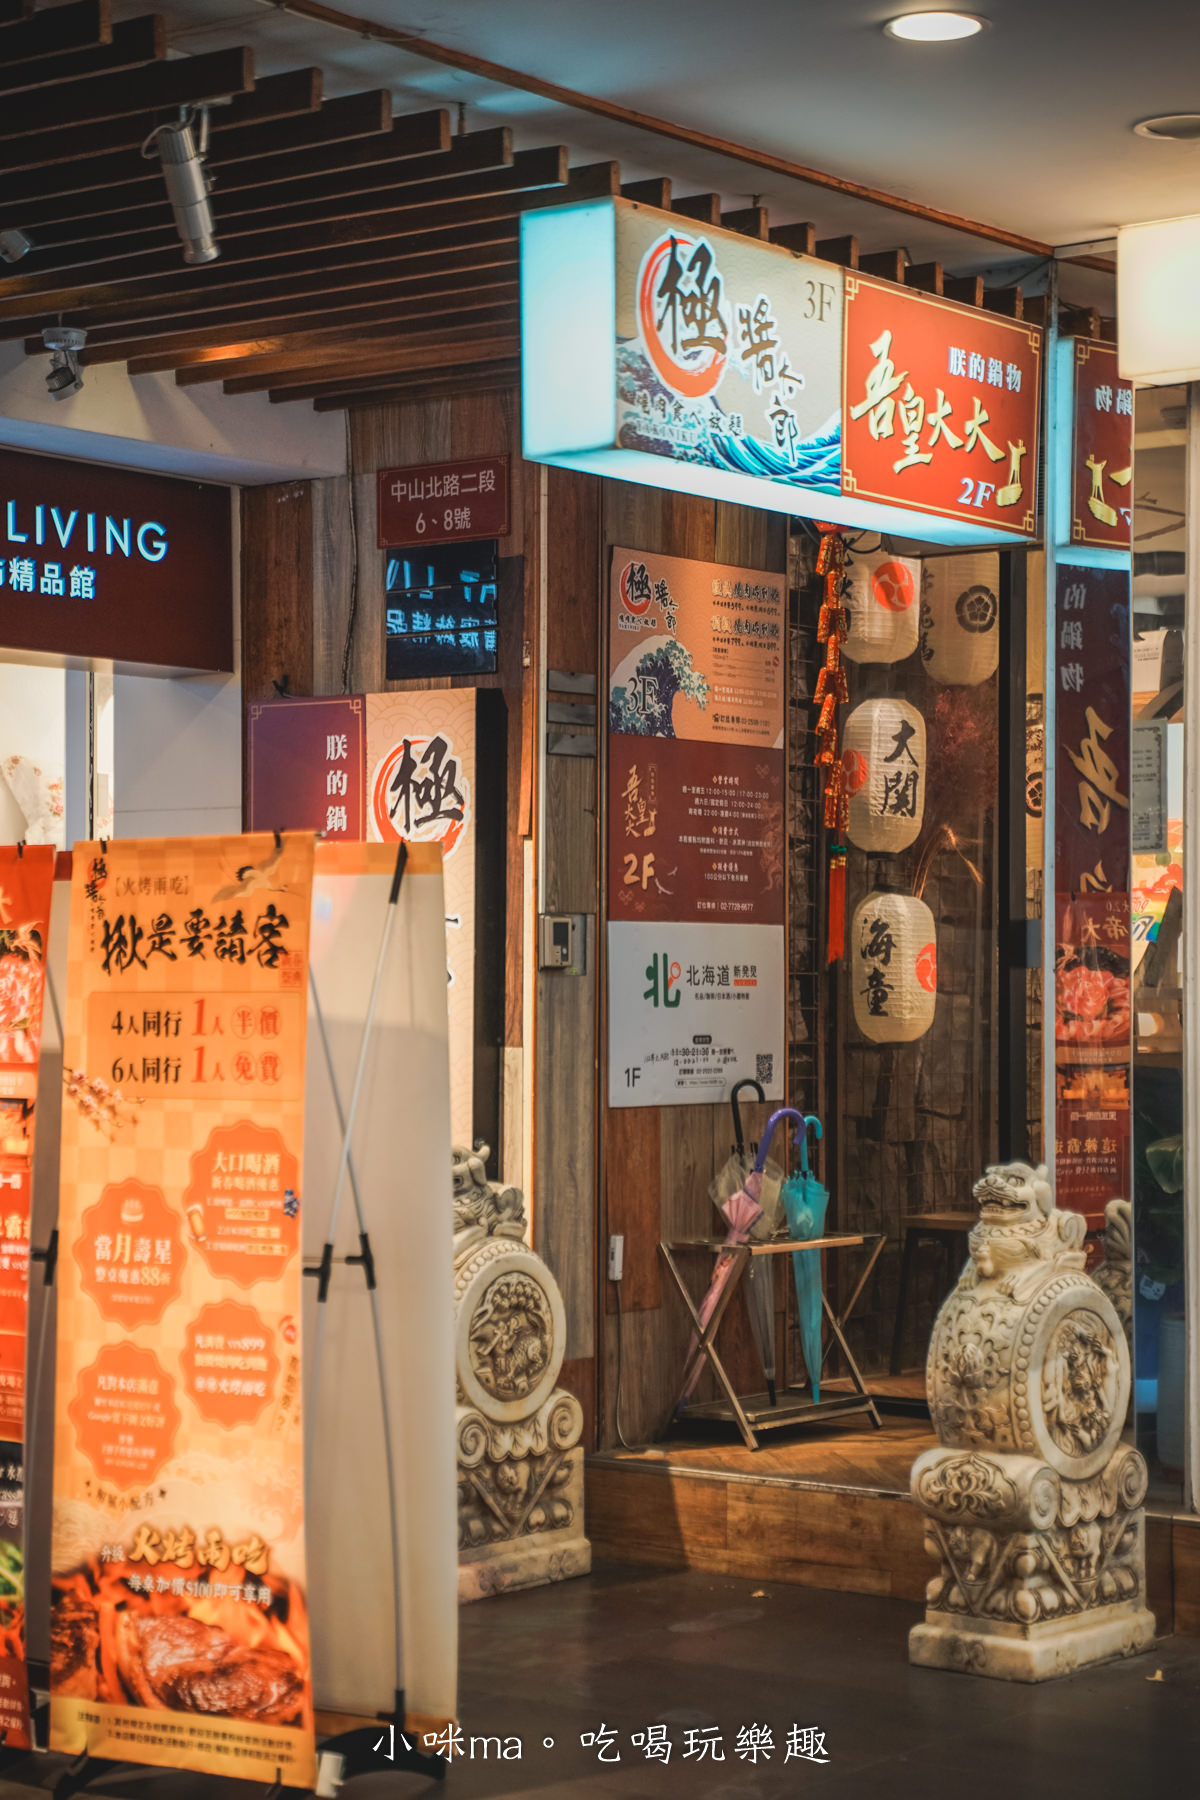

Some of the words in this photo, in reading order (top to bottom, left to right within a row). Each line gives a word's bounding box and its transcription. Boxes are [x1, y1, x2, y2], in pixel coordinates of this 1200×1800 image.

[804, 280, 836, 322] 3F
[949, 346, 1022, 393] 朕的鍋物
[851, 330, 1004, 474] 吾皇大大
[391, 469, 496, 503] 中山北路二段
[957, 477, 996, 508] 2F
[6, 499, 169, 563] LIVING
[415, 506, 472, 534] 6、8號
[627, 676, 659, 714] 3F
[326, 734, 348, 832] 朕的鍋
[624, 852, 655, 890] 2F
[686, 965, 731, 987] 北海道
[111, 1010, 183, 1038] 4人同行
[111, 1056, 183, 1085] 6人同行
[624, 1067, 641, 1089] 1F
[212, 1152, 281, 1175] 大口喝酒
[94, 1234, 172, 1265] 當月壽星
